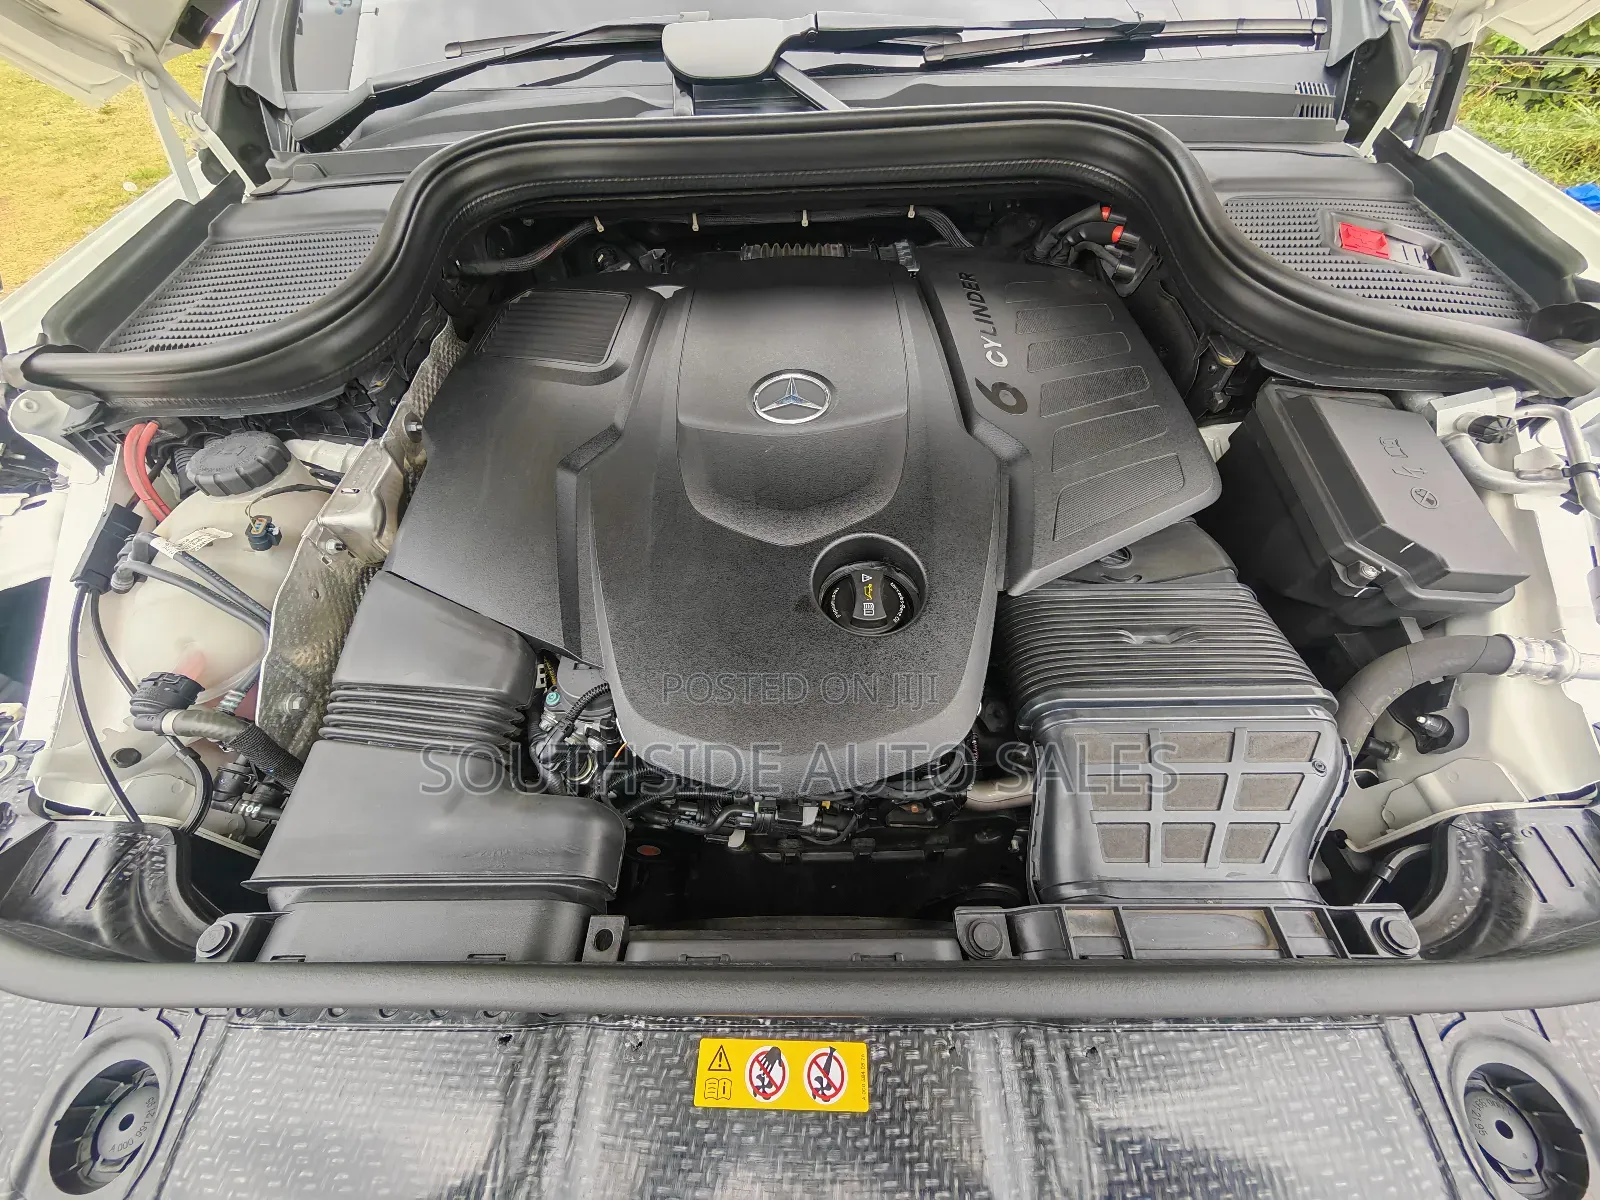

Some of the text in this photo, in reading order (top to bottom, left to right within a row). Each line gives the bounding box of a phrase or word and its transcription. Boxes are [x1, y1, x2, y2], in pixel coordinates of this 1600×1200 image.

[958, 271, 1029, 416] 6 CYLINDER
[240, 803, 261, 814] TOP
